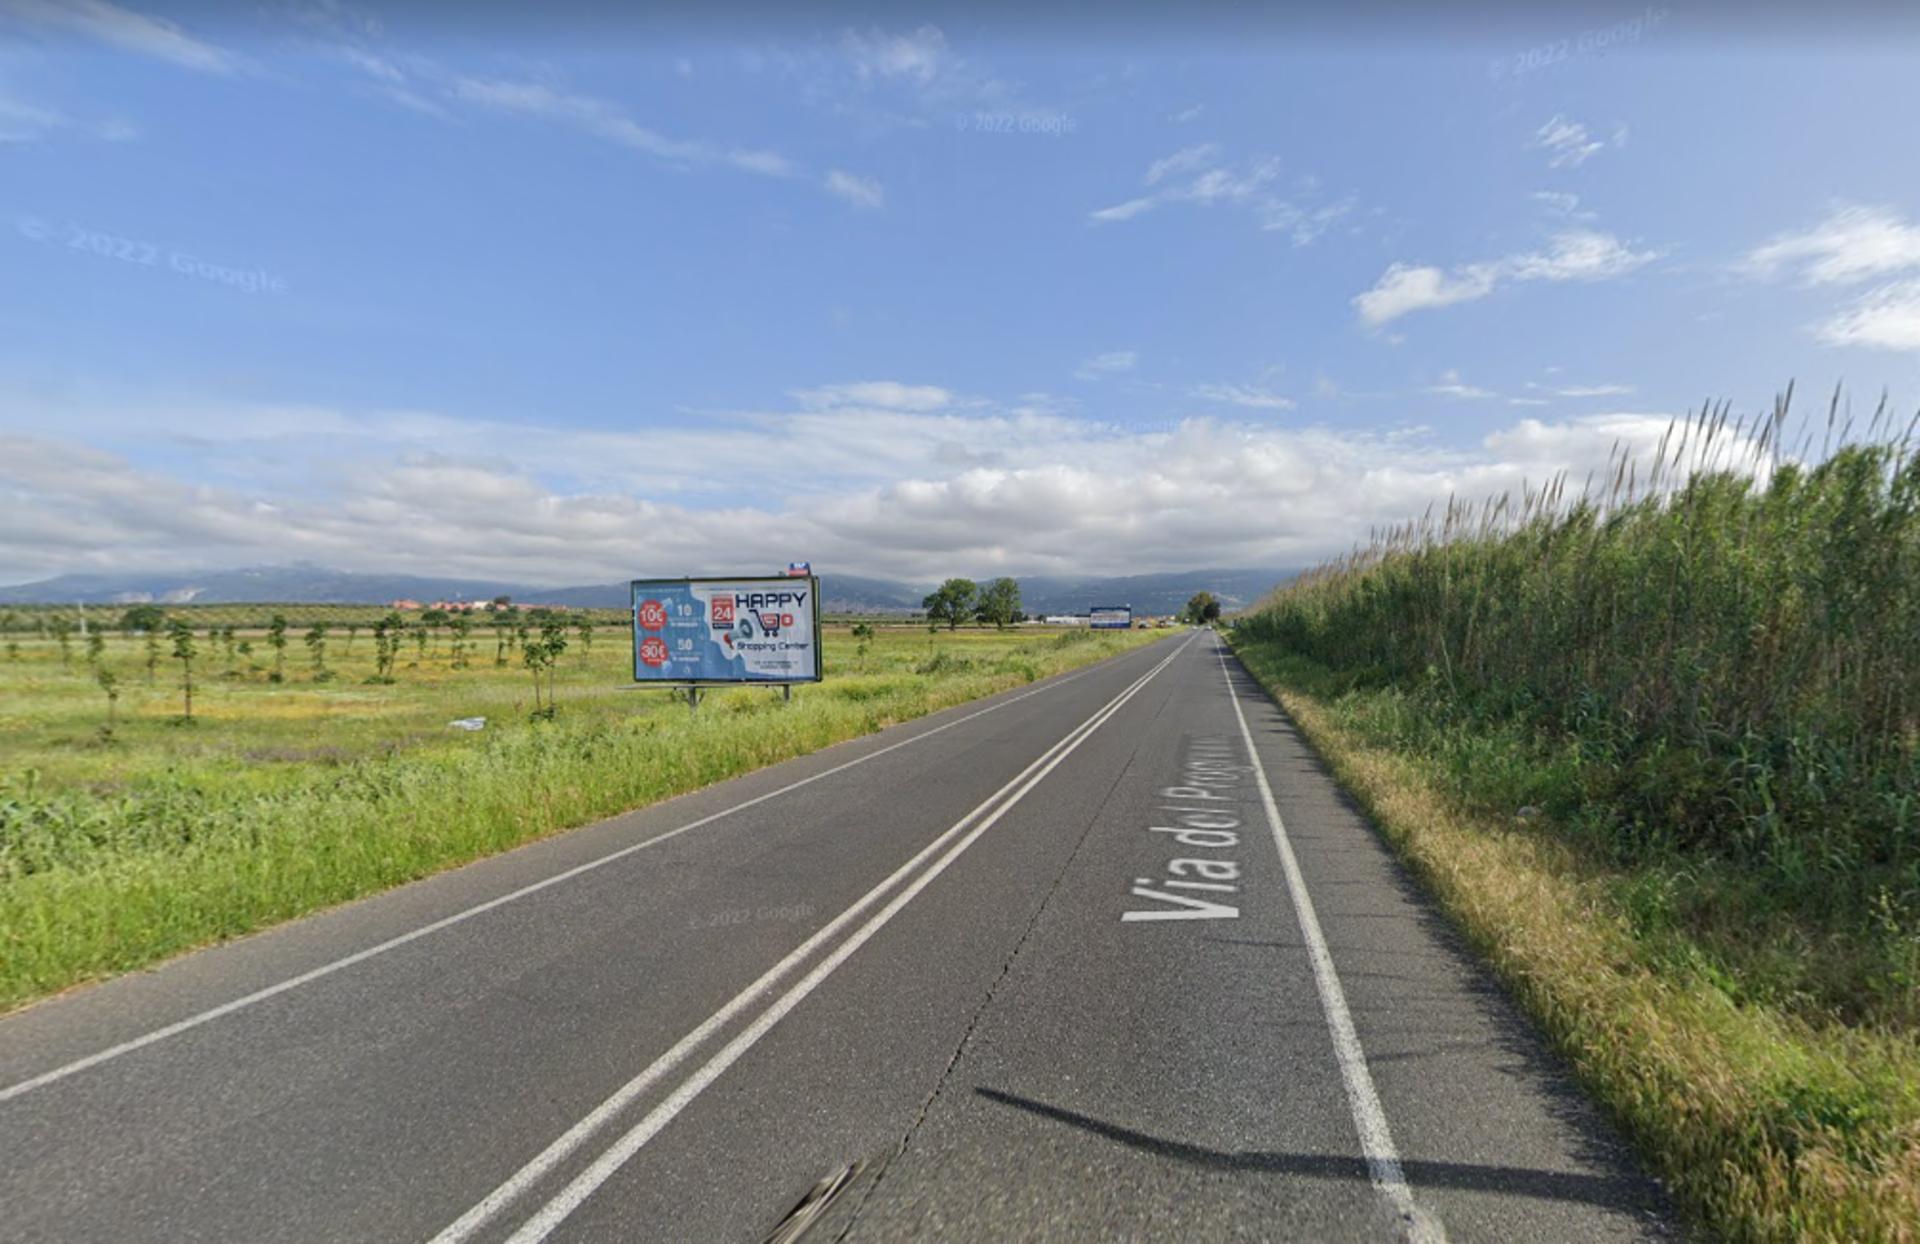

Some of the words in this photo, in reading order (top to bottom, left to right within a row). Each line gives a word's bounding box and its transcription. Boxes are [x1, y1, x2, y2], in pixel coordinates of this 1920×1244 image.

[735, 592, 807, 608] HAPPY
[714, 606, 731, 620] 24
[778, 642, 809, 650] Center
